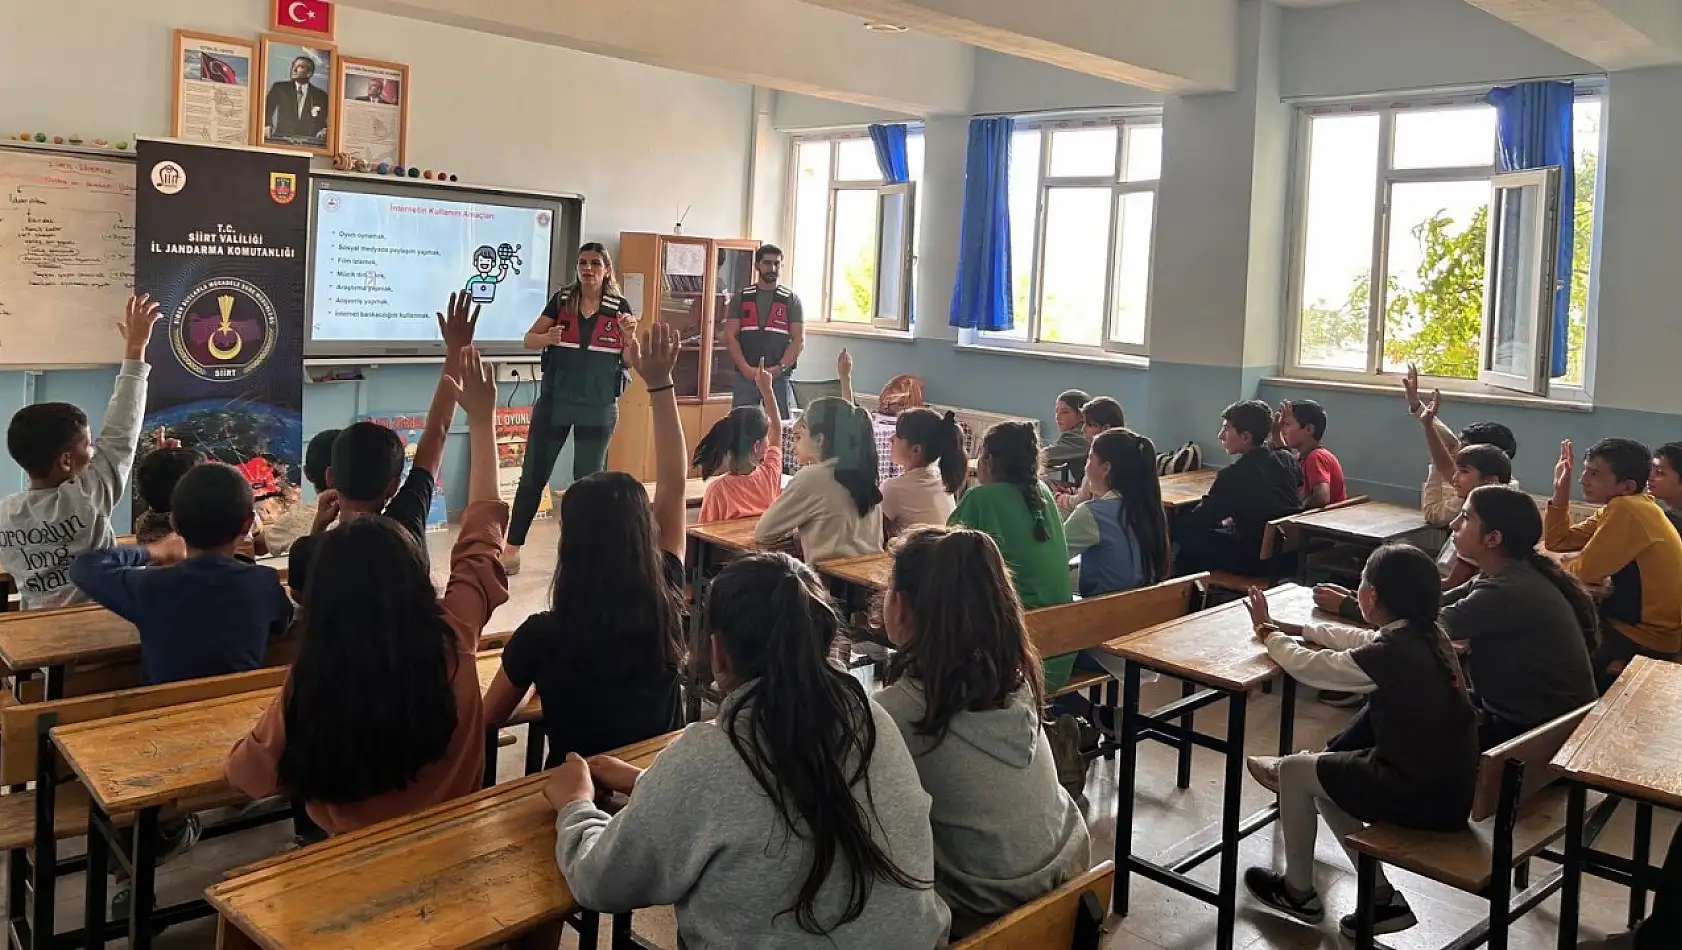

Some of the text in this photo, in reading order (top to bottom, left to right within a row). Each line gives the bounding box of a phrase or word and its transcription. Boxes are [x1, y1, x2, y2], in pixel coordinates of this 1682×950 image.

[217, 223, 236, 232] T.C.
[188, 231, 263, 245] SİİRT VALİLİĞİ
[151, 241, 295, 258] İL JANDARMA KOMUTANLIĞI
